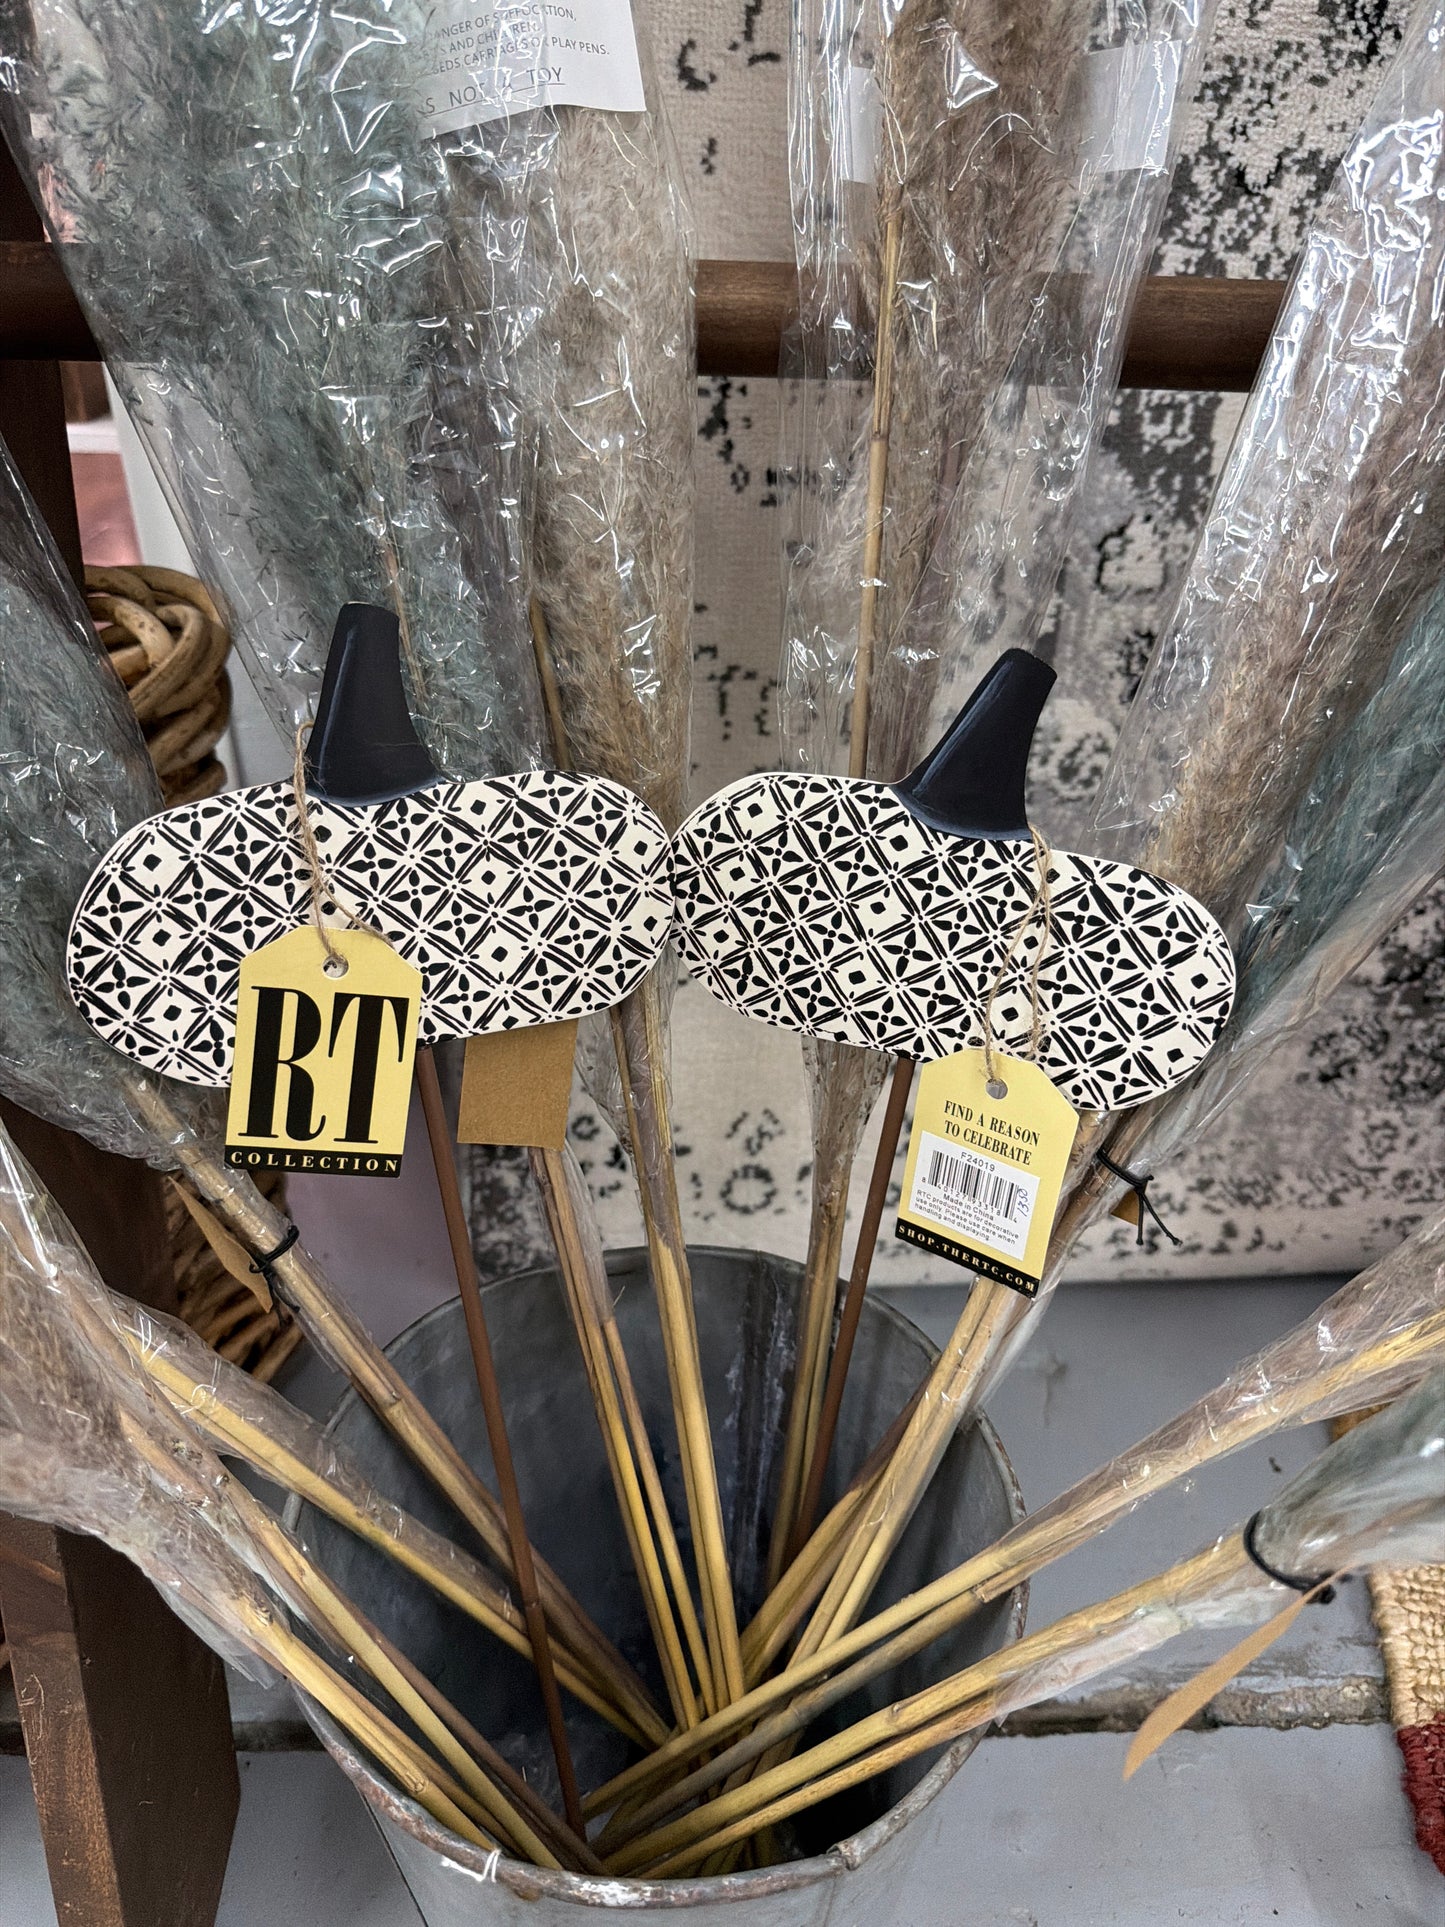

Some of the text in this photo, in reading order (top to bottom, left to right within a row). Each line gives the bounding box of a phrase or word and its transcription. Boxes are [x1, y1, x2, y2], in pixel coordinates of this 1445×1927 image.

[433, 20, 473, 38] ANGER
[474, 14, 490, 28] OF
[449, 37, 474, 53] AND
[551, 36, 577, 50] PLAY
[579, 41, 610, 55] PENS.
[526, 67, 561, 86] TOY
[238, 985, 410, 1144] RT
[943, 1100, 1040, 1147] FIND A REASON
[944, 1120, 1032, 1165] TO CELEBRATE
[230, 1151, 398, 1172] COLLECTION
[960, 1151, 996, 1172] F24019
[914, 1203, 943, 1220] handling
[943, 1216, 956, 1225] and
[917, 1189, 1020, 1240] RTC products are for decorative
[943, 1193, 994, 1222] Made in China
[916, 1197, 928, 1206] use
[945, 1208, 968, 1223] Please
[969, 1220, 981, 1229] use
[981, 1226, 996, 1236] care
[997, 1233, 1016, 1245] when
[898, 1224, 1036, 1293] SHOP.THERTC.COM
